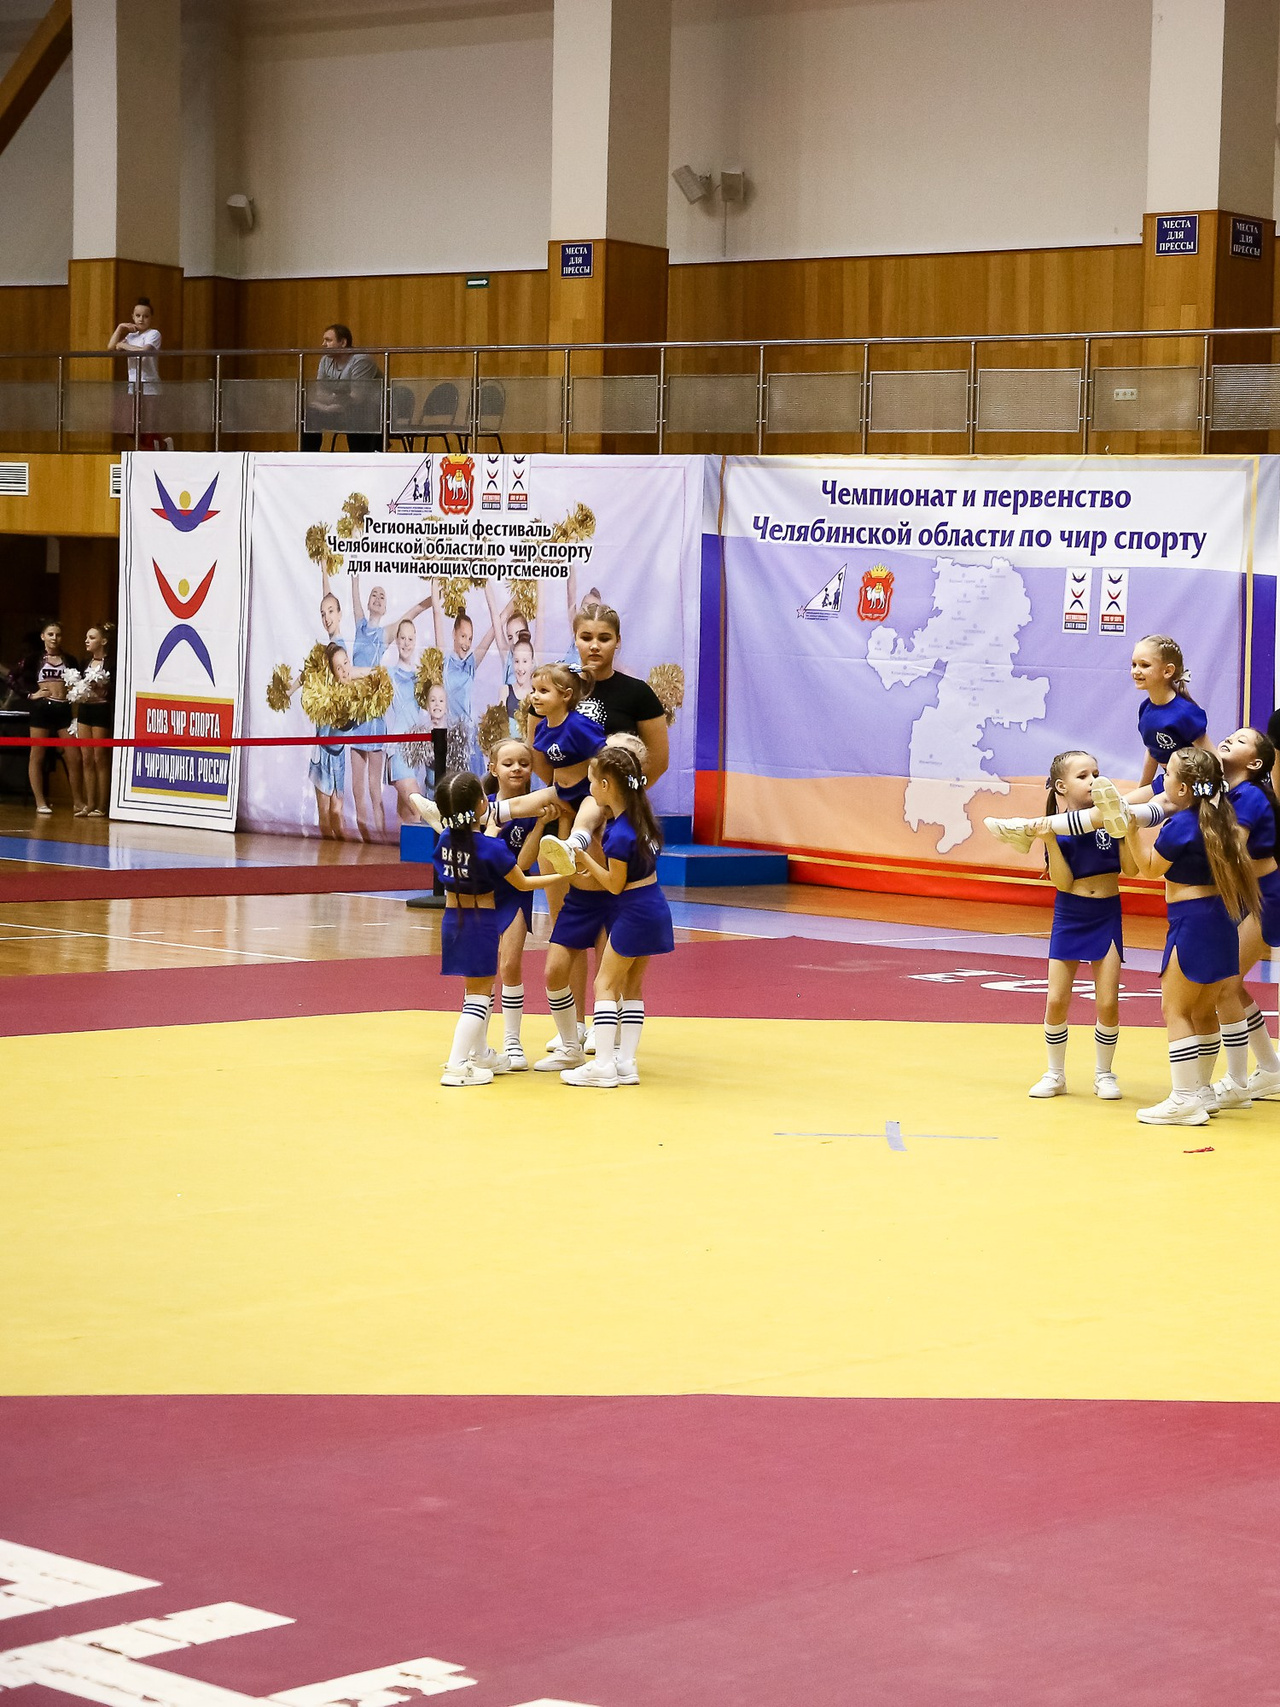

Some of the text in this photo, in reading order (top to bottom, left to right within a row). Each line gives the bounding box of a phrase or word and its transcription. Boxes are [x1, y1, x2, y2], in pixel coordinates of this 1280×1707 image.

[1162, 219, 1191, 229] МЕСТА
[1236, 222, 1259, 234] МЕСТА
[1166, 231, 1185, 241] ДЛЯ
[1239, 234, 1254, 244] ДЛЯ
[565, 246, 588, 255] МЕСТА
[1159, 241, 1194, 251] ПРЕССЫ
[1233, 243, 1261, 256] ПРЕССЫ
[568, 256, 583, 265] ДЛЯ
[562, 265, 591, 275] ПРЕССЫ
[822, 480, 1132, 516] Чемпионат и первенство
[365, 517, 552, 540] Региональный фестиваль
[753, 515, 1207, 559] Челябинской области по чир спорту
[327, 536, 593, 564] Челябинской области по чир спорту
[347, 560, 569, 580] для начинающих спортсменов
[146, 708, 221, 739] СОЮЗ ЧИР СПОРТА
[136, 751, 229, 785] И ЧИРЛИДИНГА РОССИИ
